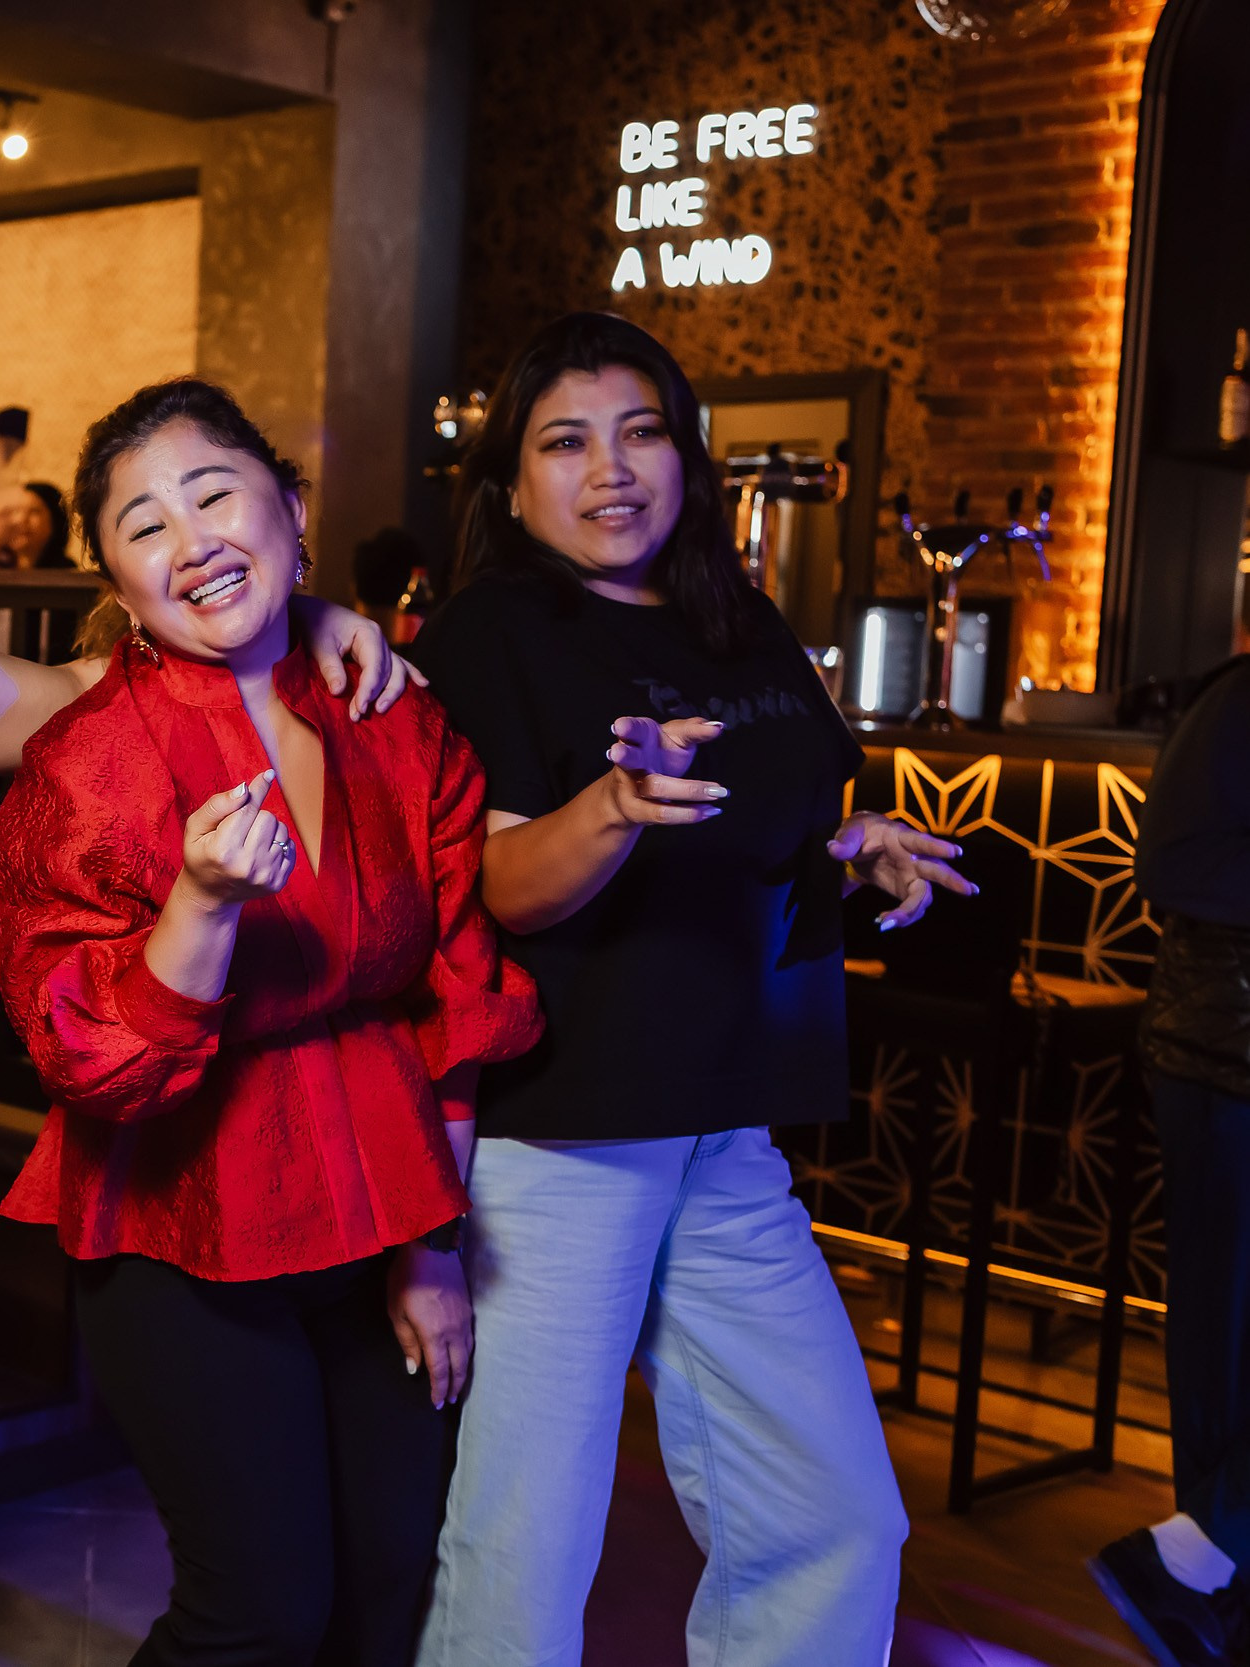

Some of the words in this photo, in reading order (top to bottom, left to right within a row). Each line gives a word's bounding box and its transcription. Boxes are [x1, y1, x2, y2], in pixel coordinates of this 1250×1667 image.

[620, 120, 680, 173] BE
[696, 104, 818, 163] FREE
[615, 177, 707, 232] LIKE
[611, 247, 646, 292] A
[659, 234, 772, 288] WIND
